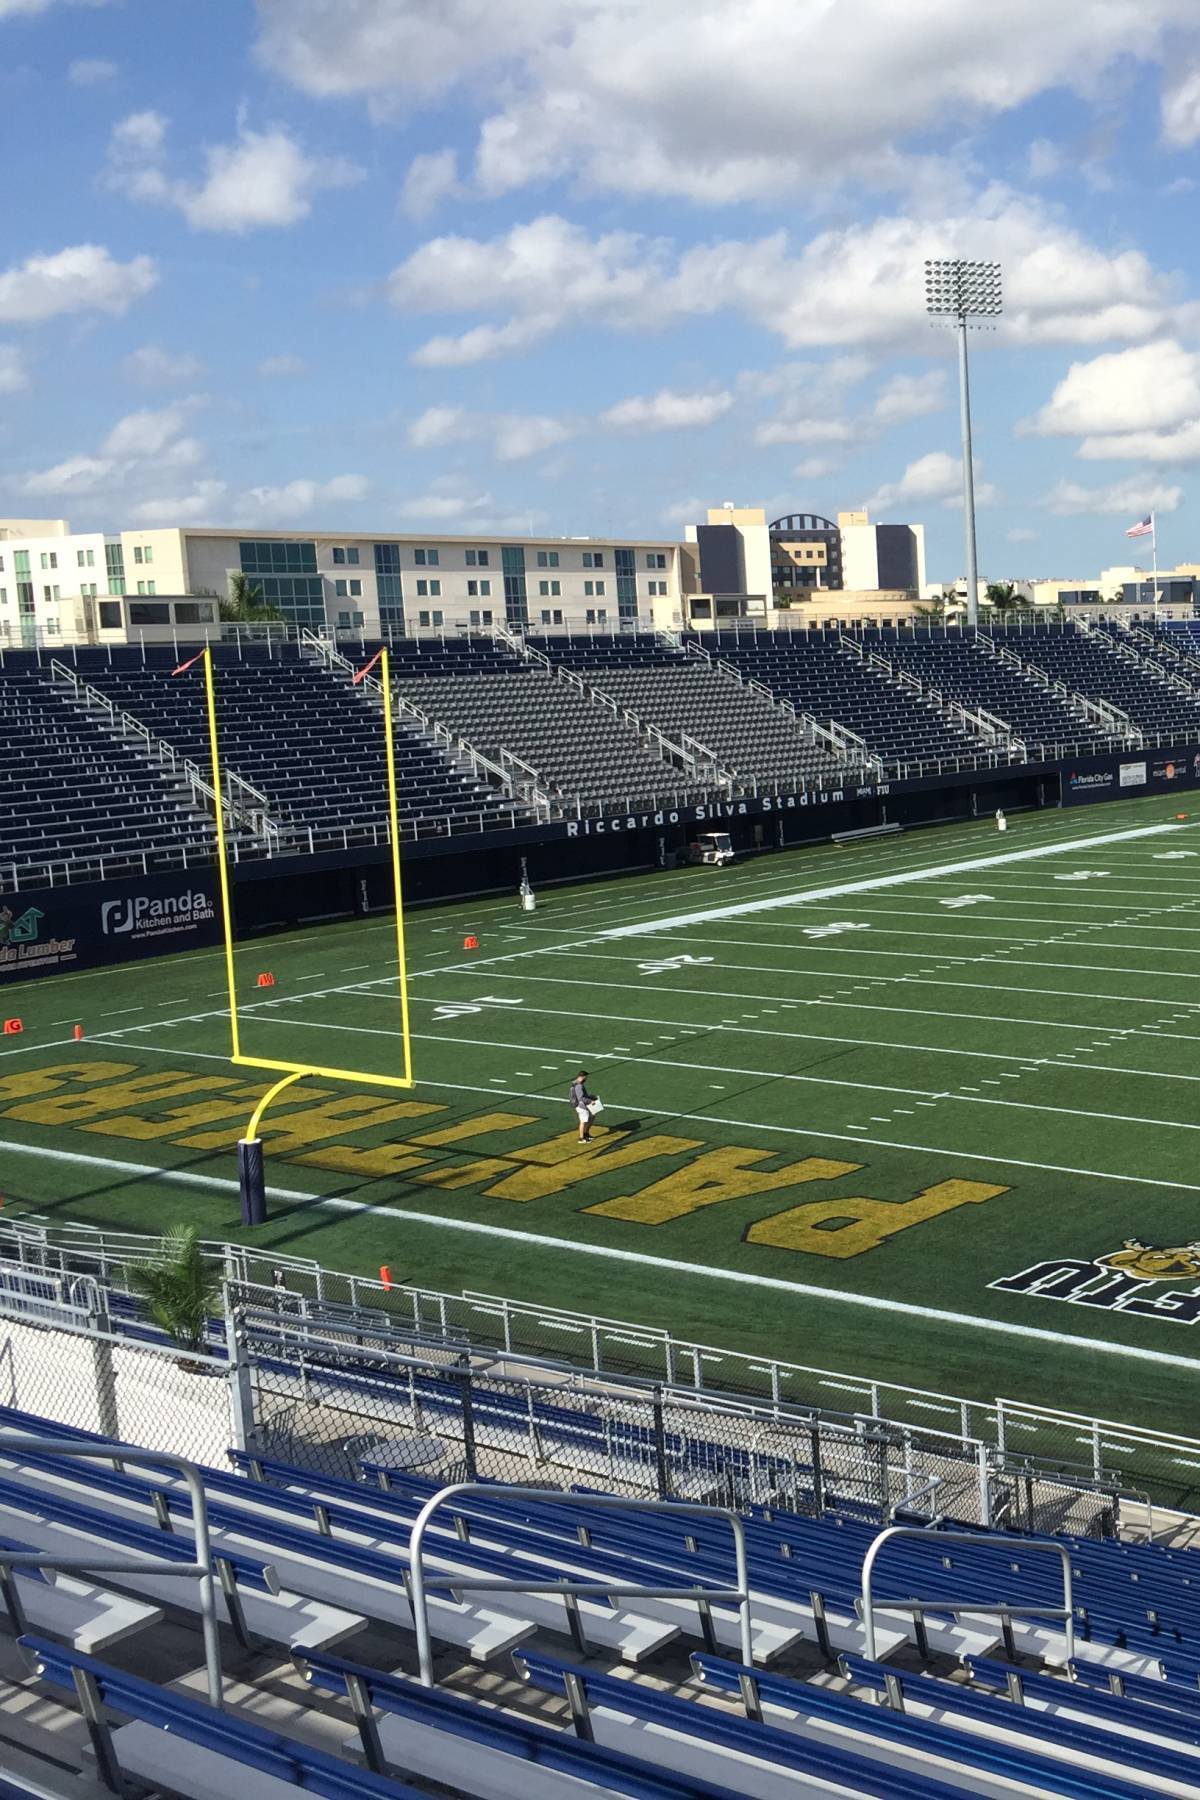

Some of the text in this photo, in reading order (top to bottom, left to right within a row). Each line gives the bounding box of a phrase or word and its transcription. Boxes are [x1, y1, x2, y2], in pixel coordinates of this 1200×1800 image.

[567, 811, 679, 837] Riccardo
[695, 802, 747, 820] Silva
[762, 790, 844, 811] Stadium
[135, 890, 207, 918] Panda
[136, 909, 215, 930] Kitchen and Bath
[18, 938, 76, 960] Lumber
[0, 1060, 1013, 1258] PANTHERS
